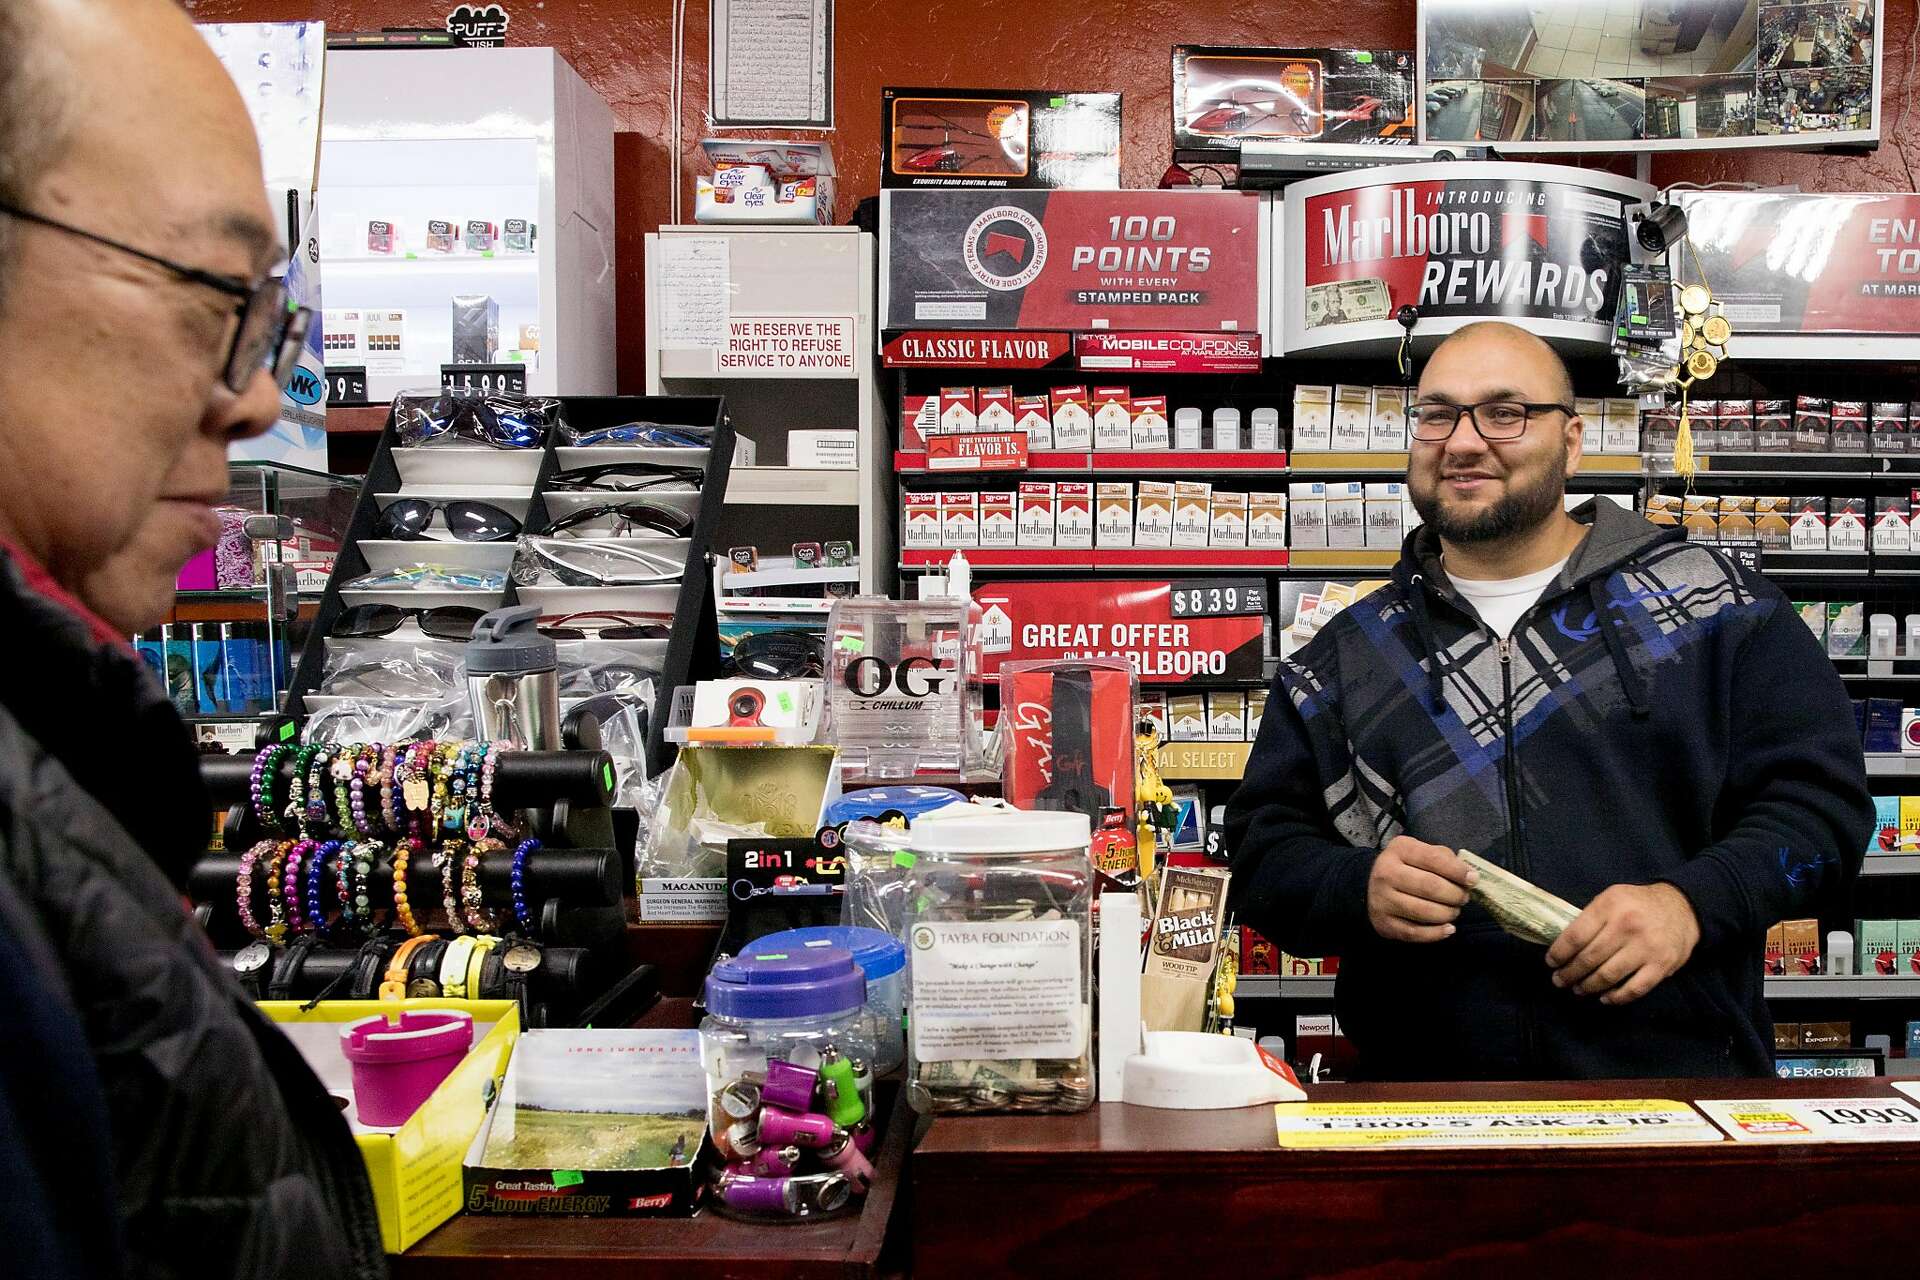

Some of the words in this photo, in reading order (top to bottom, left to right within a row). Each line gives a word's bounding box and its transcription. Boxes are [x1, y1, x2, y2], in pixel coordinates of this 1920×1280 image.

[454, 23, 497, 36] PUFF
[719, 172, 745, 180] Clear
[743, 191, 766, 200] Clear
[1427, 191, 1546, 206] INTRODUCING
[744, 200, 764, 208] eyes
[1107, 215, 1176, 241] 100
[1321, 187, 1491, 268] Marlboro
[1868, 218, 1920, 243] EN
[966, 236, 975, 263] TERMS
[1031, 232, 1045, 271] SMOKERS
[1071, 246, 1211, 272] POINTS
[975, 270, 1000, 287] ENTRY
[1001, 279, 1022, 288] CODE
[1100, 278, 1133, 287] WITH
[1138, 278, 1178, 287] EVERY
[1420, 260, 1607, 312] REWARDS
[1862, 283, 1879, 295] AT
[1884, 284, 1920, 296] MAR
[1077, 292, 1151, 304] STAMPED
[1158, 293, 1200, 304] PACK
[730, 324, 750, 336] WE
[754, 324, 813, 336] RESERVE
[816, 324, 841, 336] THE
[729, 339, 768, 351] RIGHT
[772, 339, 788, 351] TO
[792, 339, 842, 351] REFUSE
[902, 339, 975, 359] CLASSIC
[980, 340, 1050, 359] FLAVOR
[1102, 340, 1168, 350] MOBILE
[1169, 340, 1249, 351] COUPONS
[721, 354, 774, 367] SERVICE
[778, 354, 795, 367] TO
[799, 354, 851, 367] ANYONE
[1056, 423, 1088, 438] Marlboro
[1098, 423, 1128, 437] Marlboro
[1133, 427, 1168, 444] Marlboro
[958, 442, 1002, 456] FLAVOR
[1006, 442, 1021, 454] IS.
[907, 524, 940, 540] Marlboro
[944, 524, 977, 540] Marlboro
[981, 524, 1015, 540] Marlboro
[1019, 519, 1053, 536] Marlboro
[1058, 519, 1091, 536] Marlboro
[1099, 519, 1131, 534] Marlboro
[1139, 518, 1170, 533] Marlboro
[1175, 518, 1207, 534] Marlboro
[1213, 524, 1244, 540] Marlboro
[1251, 525, 1283, 540] Marlboro
[1792, 530, 1826, 546] Marlboro
[1831, 532, 1864, 547] Marlboro
[1875, 530, 1909, 546] Marlboro
[1739, 551, 1756, 559] Plus
[1174, 587, 1238, 614] $8.39
[983, 626, 1012, 646] arlboro
[1022, 624, 1103, 647] GREAT
[1111, 624, 1190, 647] OFFER
[844, 656, 946, 698] OG
[872, 701, 924, 711] CHILLUM
[1212, 722, 1242, 735] Marlboro
[1182, 752, 1237, 768] SELECT
[1105, 814, 1123, 823] Berry
[1207, 831, 1219, 854] $
[1158, 911, 1216, 934] Black
[940, 933, 979, 945] TAYBA
[982, 931, 1070, 944] FOUNDATION
[1153, 931, 1173, 955] &
[1172, 927, 1216, 950] Mild
[1162, 961, 1184, 970] WOOD
[1185, 964, 1198, 972] TIP
[1299, 1023, 1330, 1032] Newport
[1793, 1067, 1852, 1077] EXPORT
[495, 1181, 521, 1191] Great
[523, 1182, 559, 1193] Tasting
[635, 1195, 670, 1209] Berry
